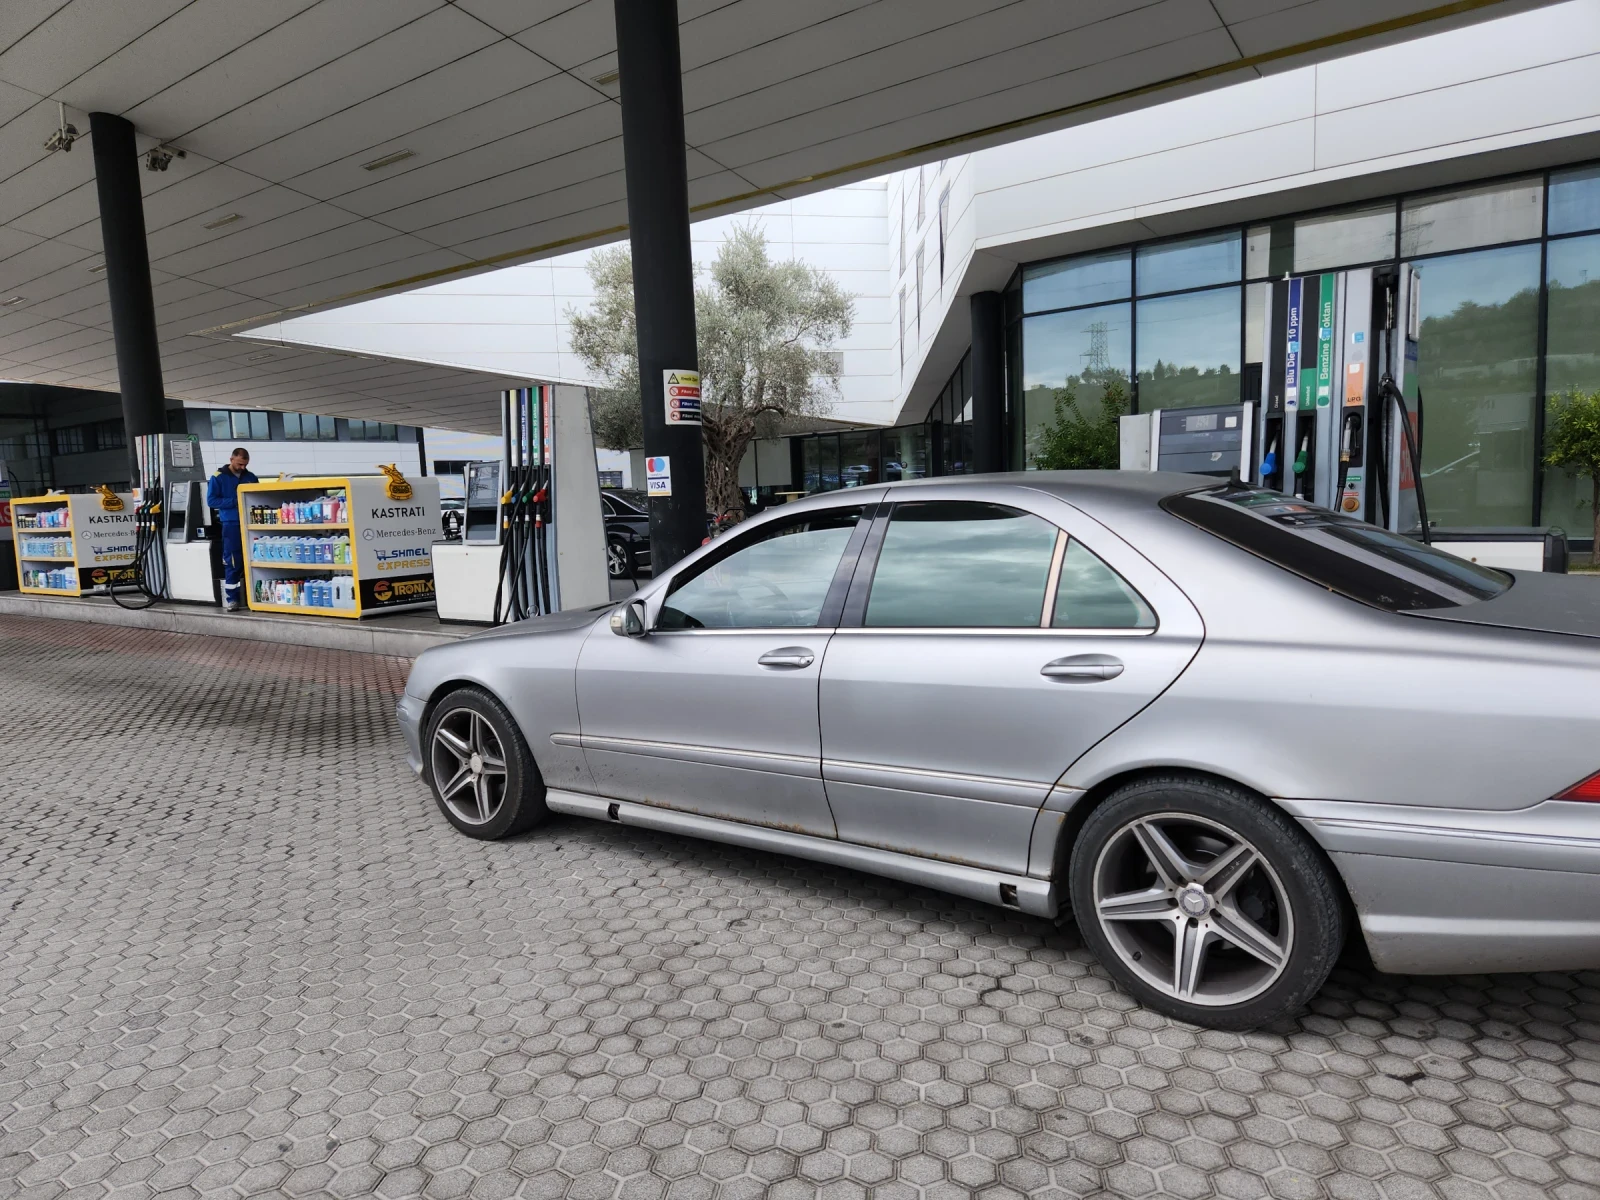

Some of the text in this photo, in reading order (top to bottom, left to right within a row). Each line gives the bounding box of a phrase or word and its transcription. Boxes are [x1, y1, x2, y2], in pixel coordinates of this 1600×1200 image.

[1322, 302, 1331, 328] oktan
[1289, 328, 1296, 338] 10
[1320, 343, 1330, 380] Benzine
[650, 481, 666, 489] VISA
[372, 506, 425, 518] KASTRATI
[376, 528, 436, 538] Mercedes-Benz
[392, 548, 428, 558] SHMEL
[377, 558, 430, 570] EXPRESS
[392, 580, 434, 596] TRONIX
